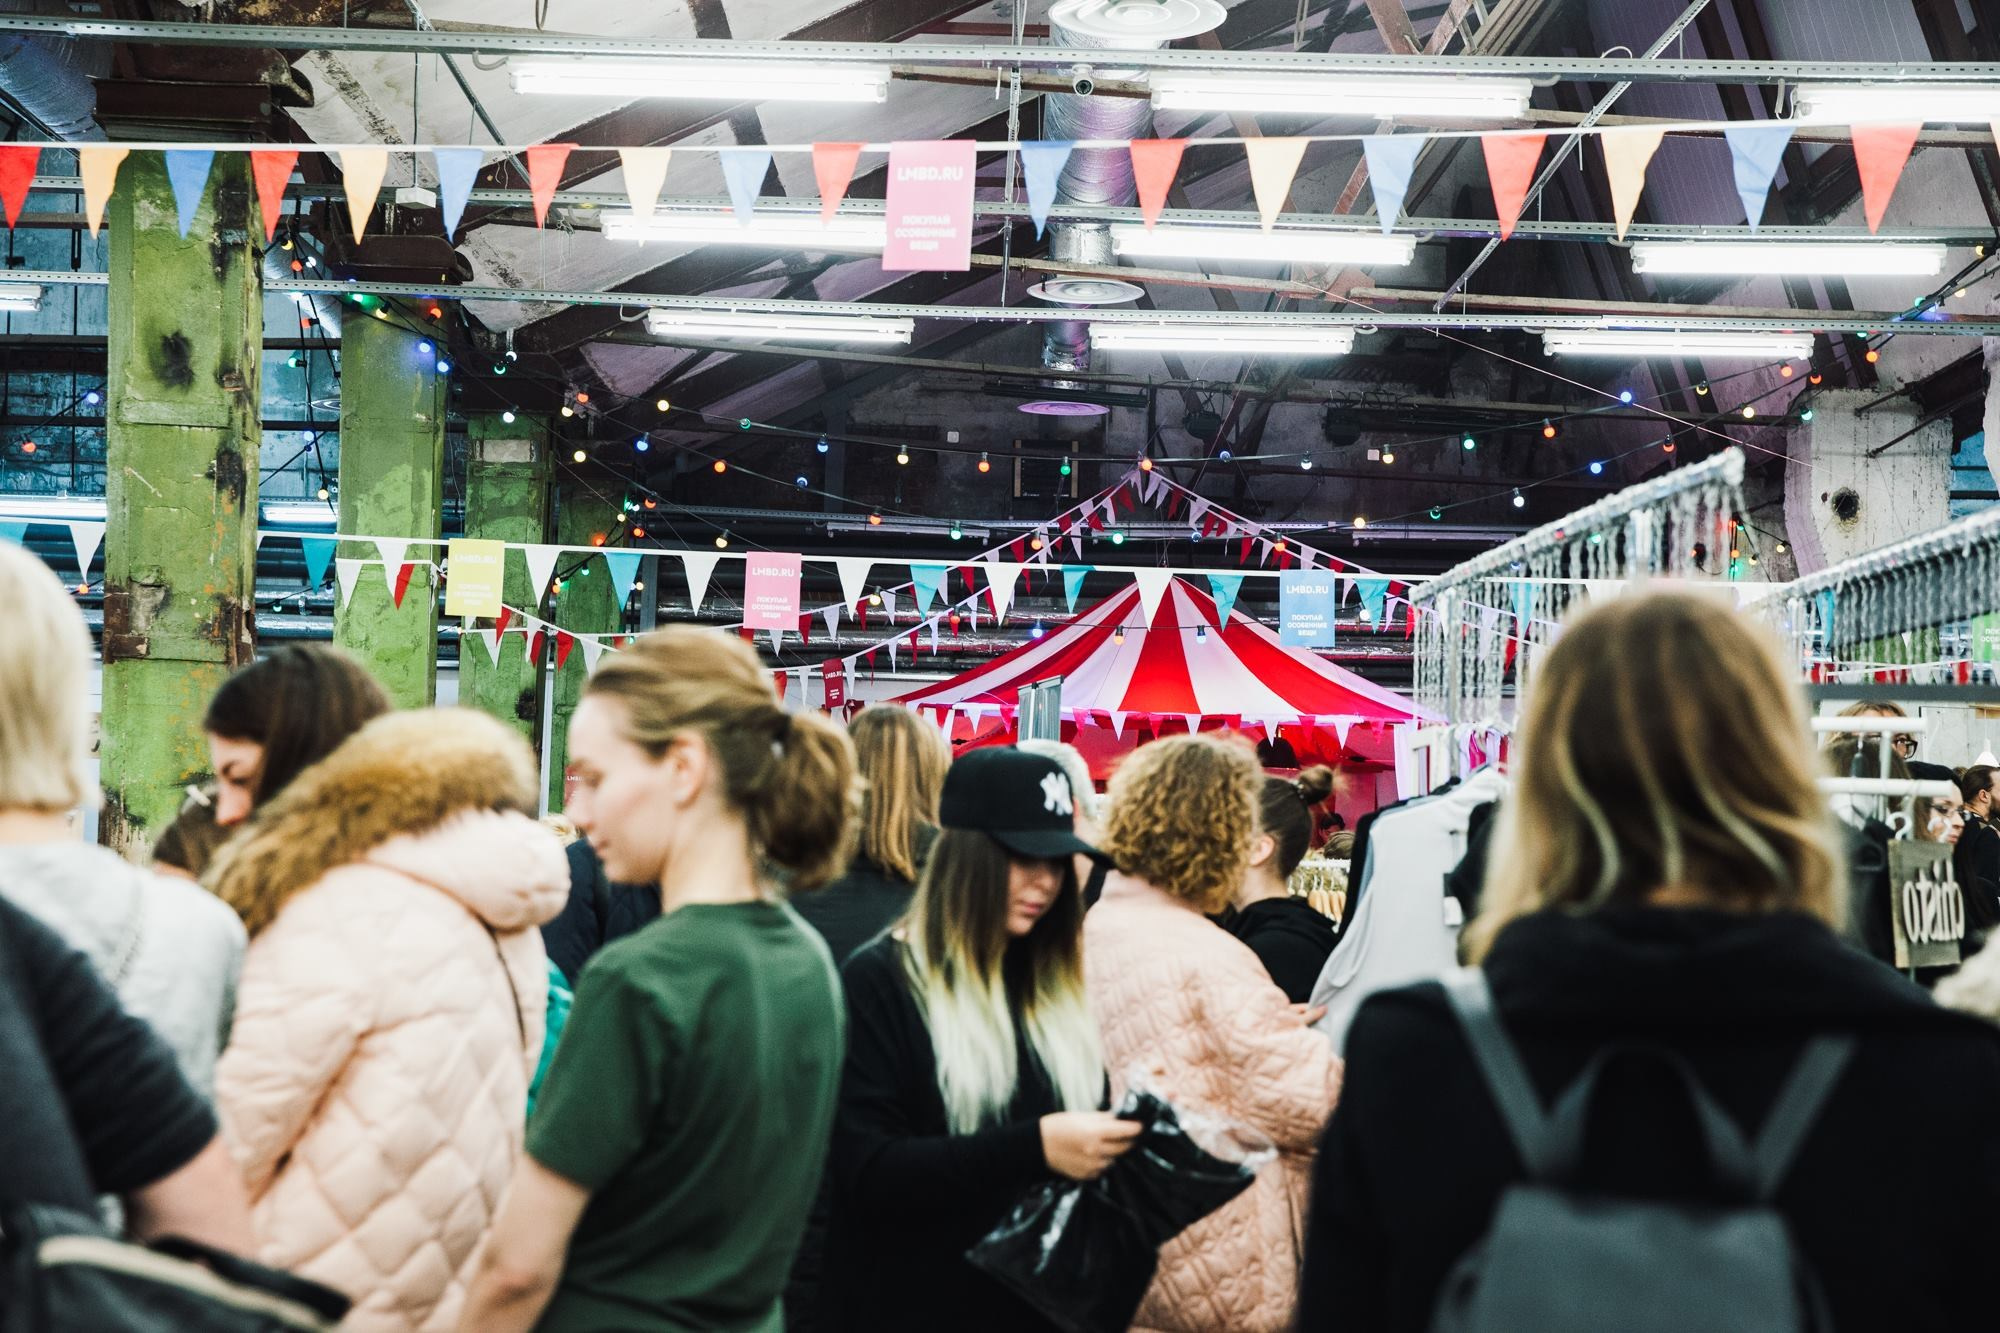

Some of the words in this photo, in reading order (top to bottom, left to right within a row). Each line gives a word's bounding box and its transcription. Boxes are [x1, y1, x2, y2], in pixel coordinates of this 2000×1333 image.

[897, 166, 963, 181] LMBD.RU
[752, 567, 795, 577] LMBD.RU
[1286, 585, 1329, 594] LMBD.RU
